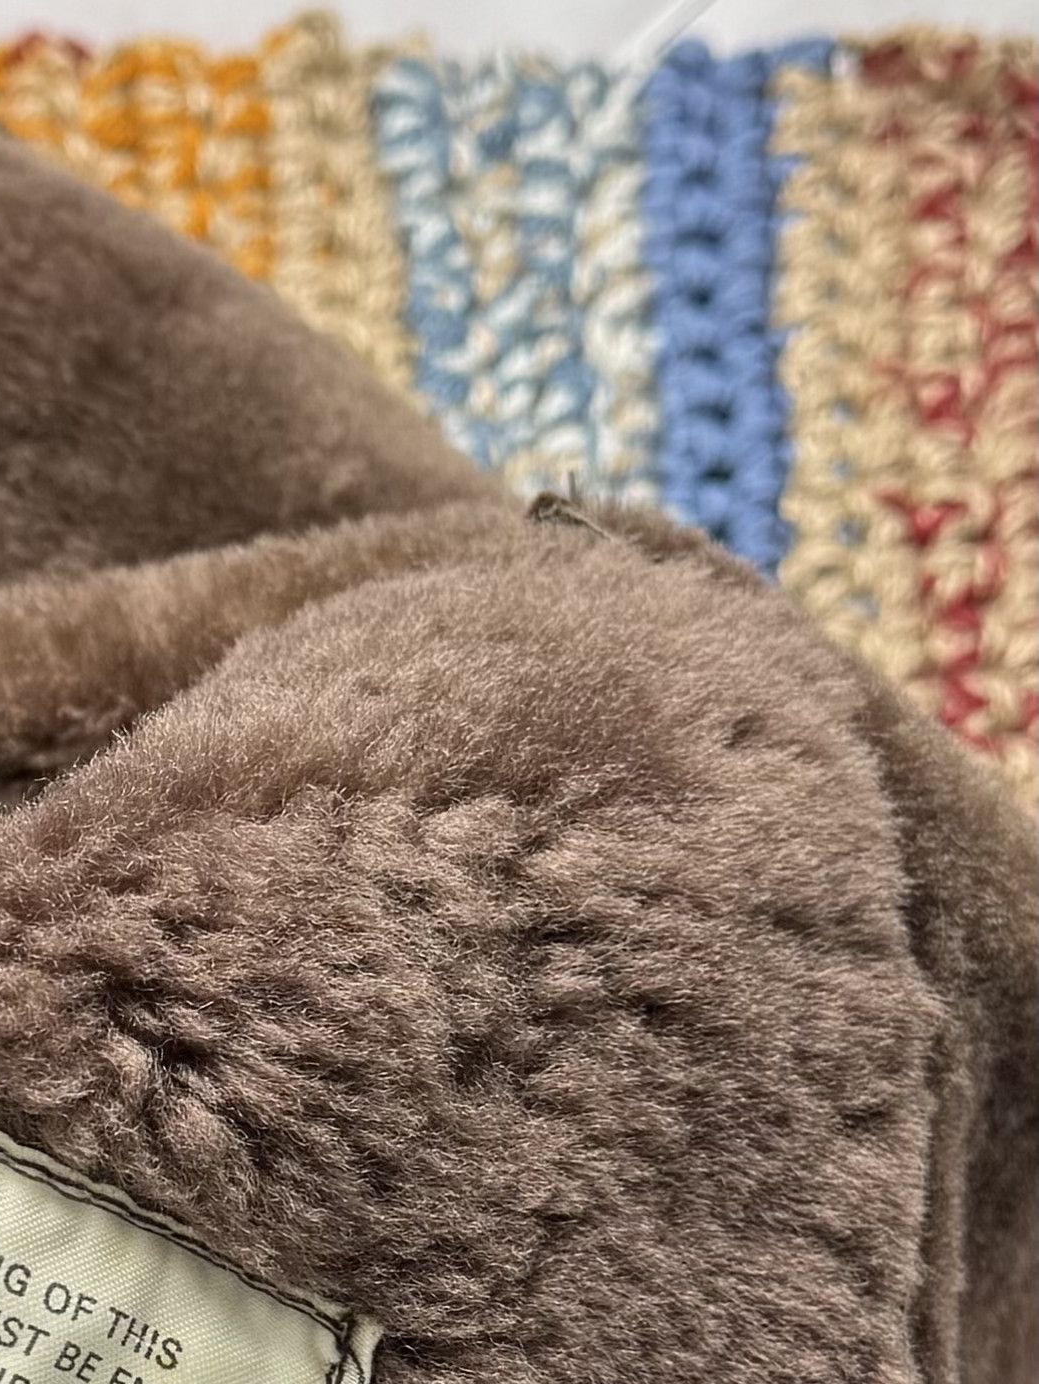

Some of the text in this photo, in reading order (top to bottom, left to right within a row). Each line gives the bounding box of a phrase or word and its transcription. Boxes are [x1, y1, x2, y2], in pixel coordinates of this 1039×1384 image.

[43, 1282, 98, 1321] OF
[107, 1306, 183, 1370] THIS
[54, 1340, 103, 1383] BE
